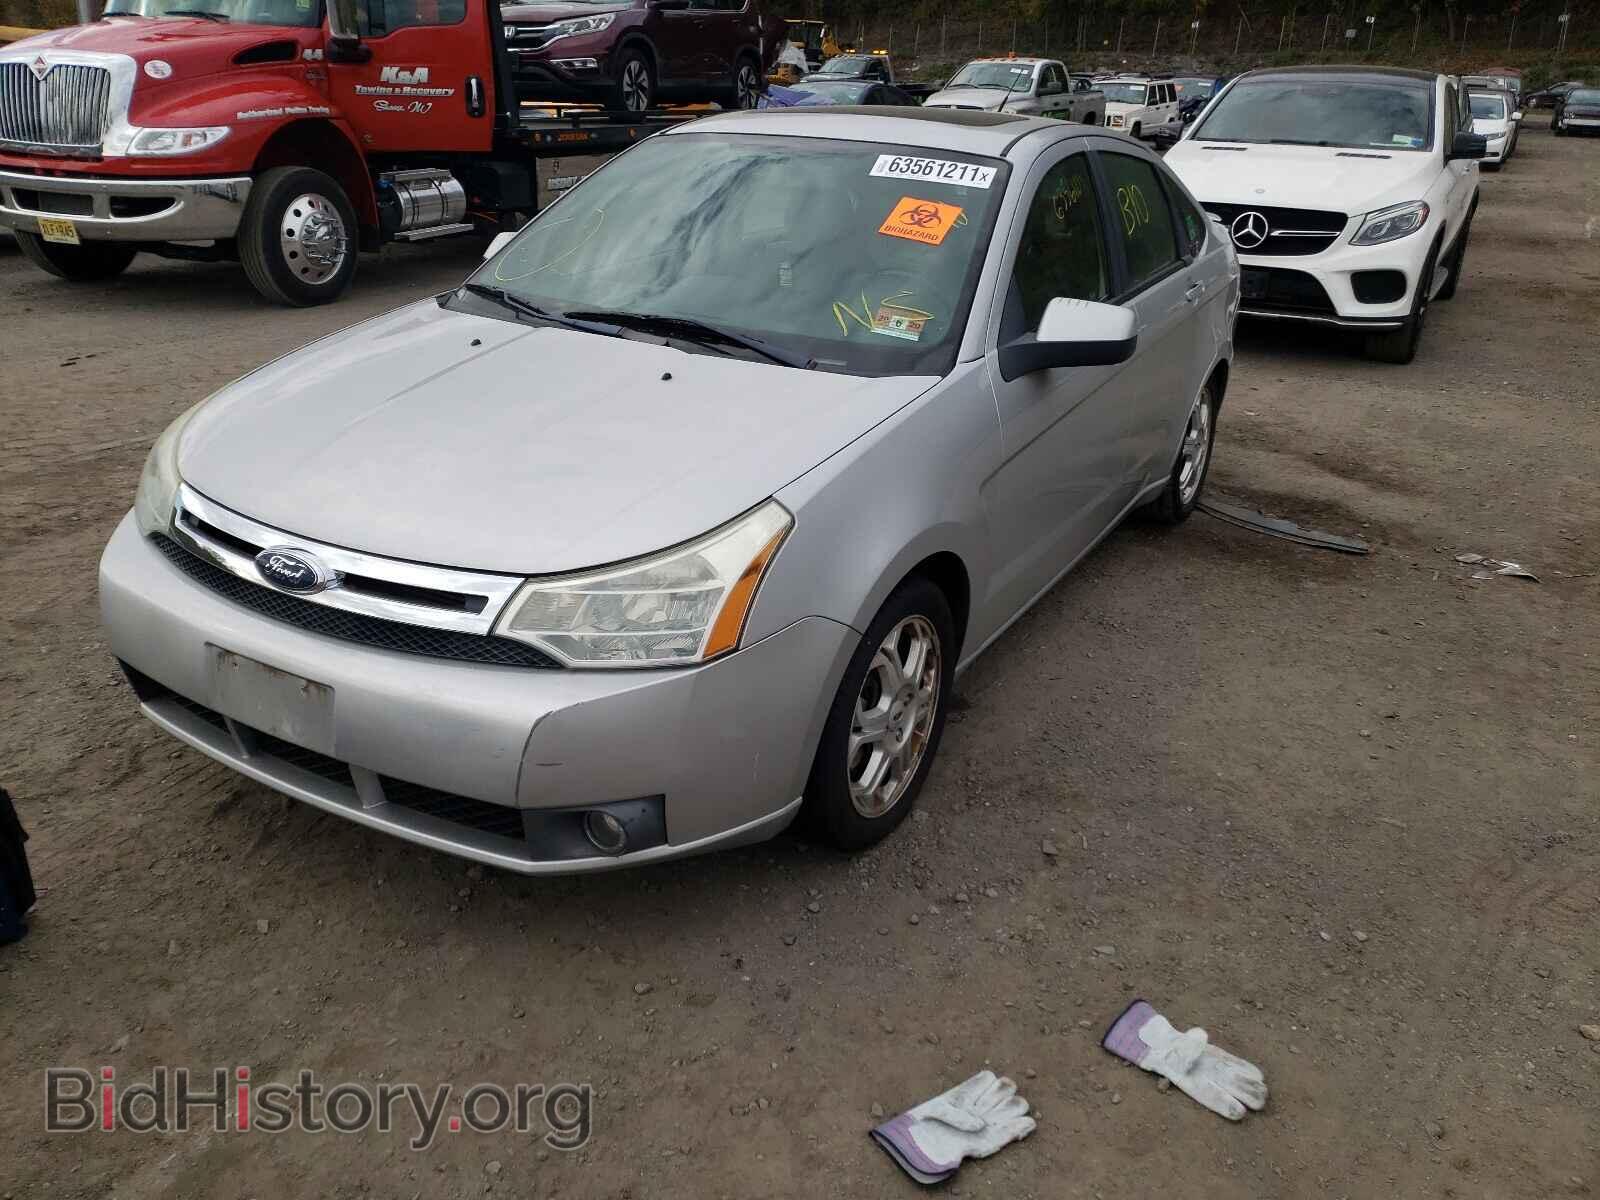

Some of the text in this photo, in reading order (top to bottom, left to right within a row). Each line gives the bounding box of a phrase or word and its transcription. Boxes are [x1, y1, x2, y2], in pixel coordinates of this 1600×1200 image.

[354, 84, 393, 95] Towing
[402, 86, 455, 96] Recovery
[884, 223, 939, 241] BIOHAZARD
[264, 555, 307, 578] Ford
